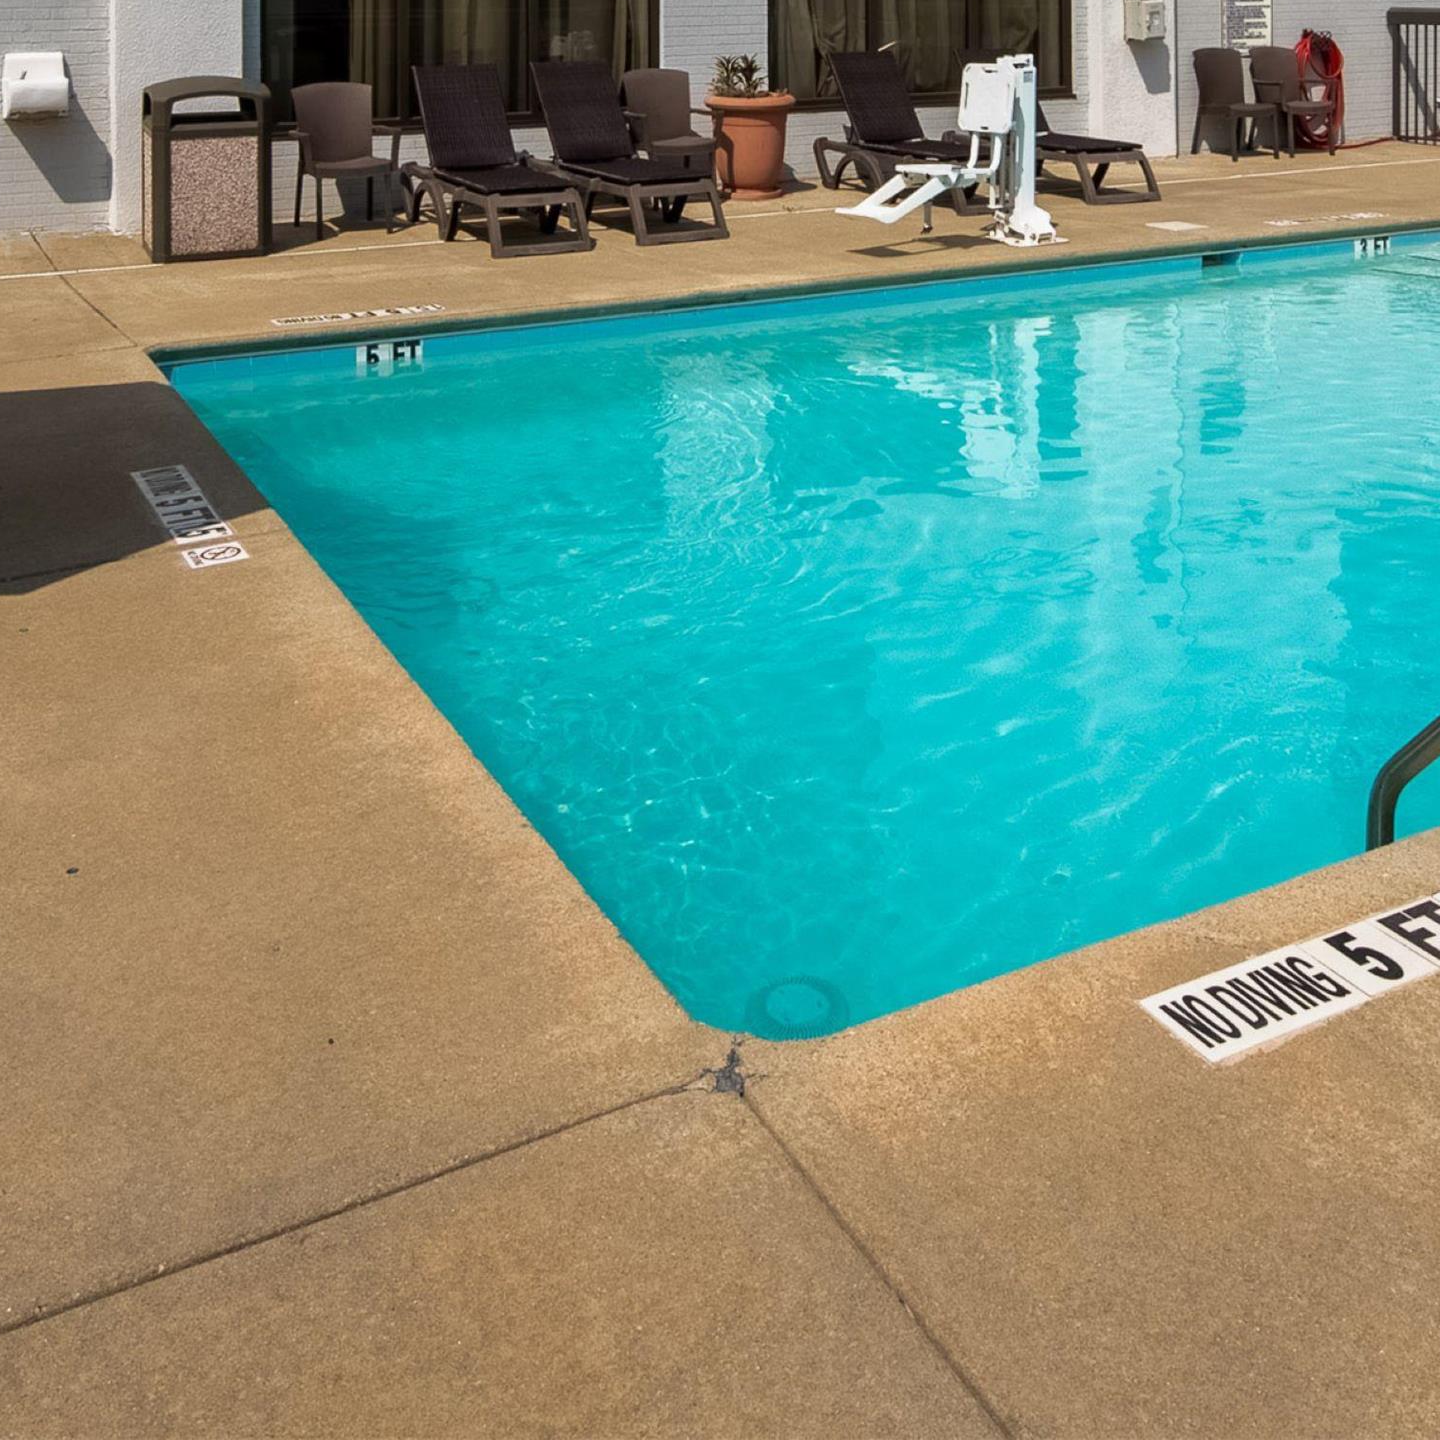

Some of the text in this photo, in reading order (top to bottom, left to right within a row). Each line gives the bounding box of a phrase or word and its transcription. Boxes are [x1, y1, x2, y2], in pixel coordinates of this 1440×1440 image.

[393, 340, 421, 360] FT
[1159, 994, 1242, 1048] NO
[1205, 956, 1351, 1030] DIVING
[1323, 932, 1404, 981] 5
